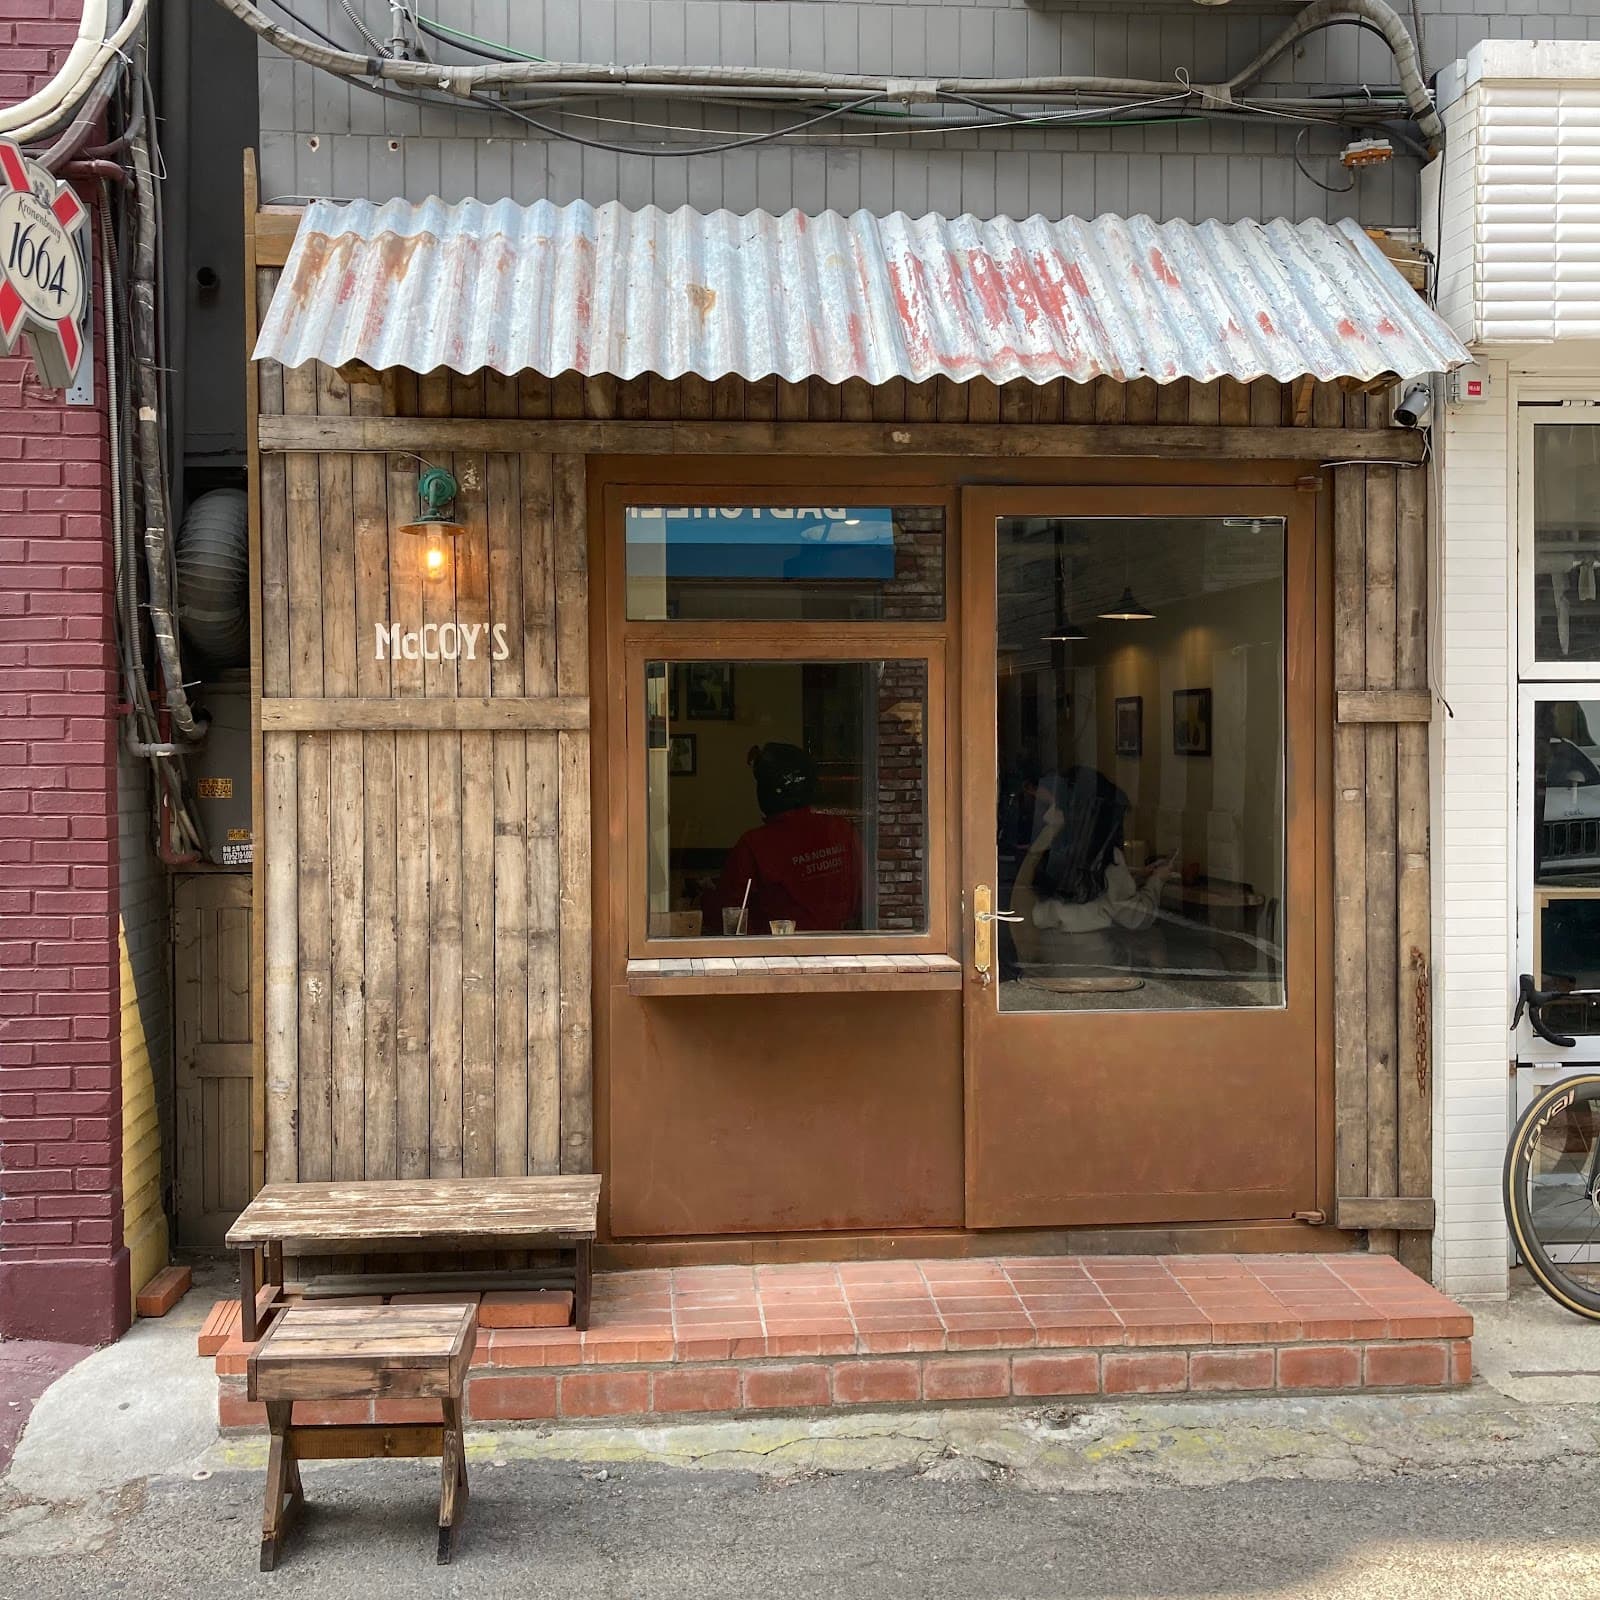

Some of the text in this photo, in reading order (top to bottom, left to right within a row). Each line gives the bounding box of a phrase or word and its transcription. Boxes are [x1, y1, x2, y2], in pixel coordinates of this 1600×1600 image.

[17, 195, 62, 243] Kronenbourg
[8, 221, 70, 305] 1664
[374, 622, 510, 661] McCOY'S
[1524, 1088, 1575, 1162] roval
